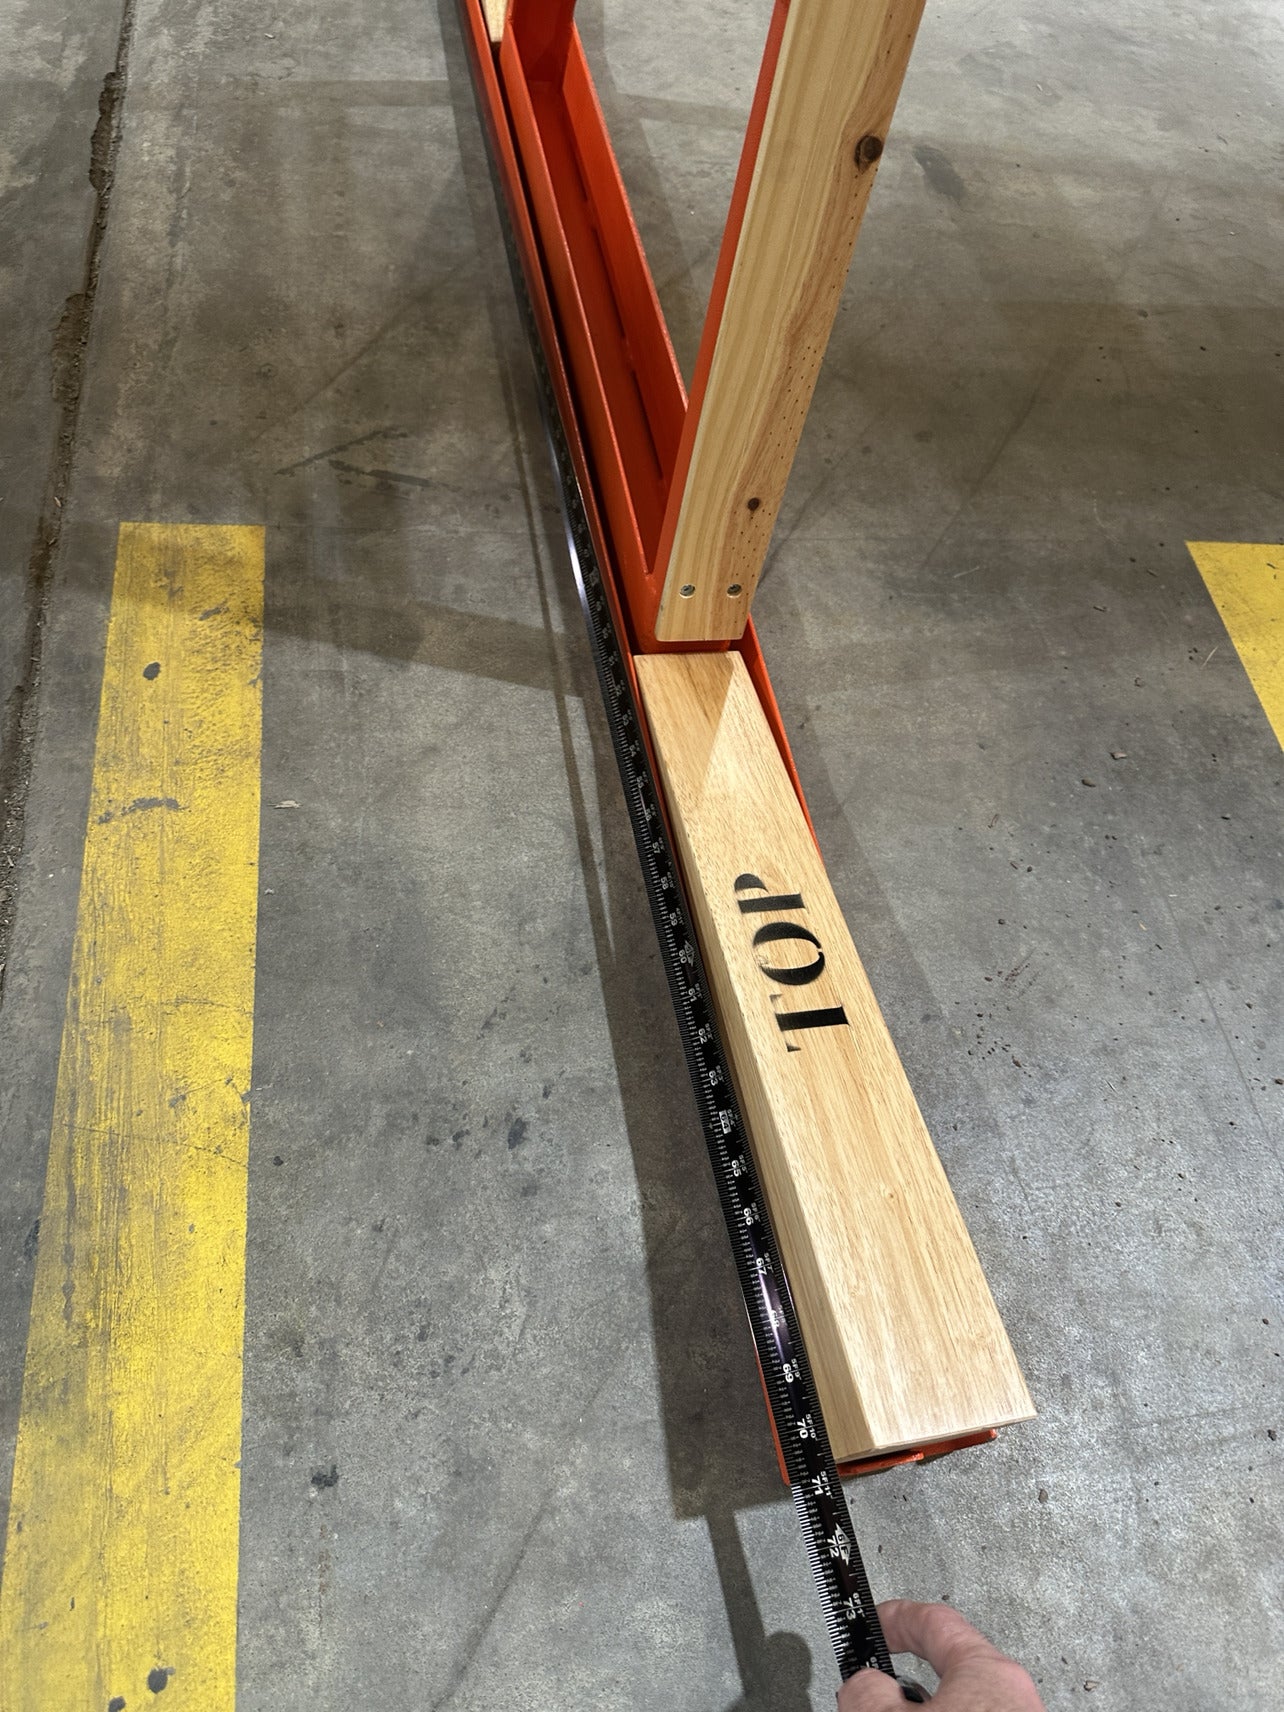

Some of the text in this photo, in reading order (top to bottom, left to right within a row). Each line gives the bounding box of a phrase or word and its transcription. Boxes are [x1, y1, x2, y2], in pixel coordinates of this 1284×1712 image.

[652, 841, 660, 854] 57
[661, 876, 668, 890] 58
[669, 912, 678, 926] 59
[679, 949, 687, 964] 60
[734, 873, 850, 1052] TOP
[688, 988, 697, 1002] 61
[698, 1028, 707, 1044] 62
[708, 1070, 718, 1086] 63
[731, 1160, 742, 1177] 65
[743, 1207, 754, 1226] 66
[756, 1257, 767, 1276] 67
[771, 1309, 780, 1328] 68
[783, 1363, 794, 1383] 69
[797, 1418, 809, 1439] 70
[811, 1475, 823, 1495] 71
[827, 1535, 839, 1558] 72
[843, 1597, 857, 1620] 73
